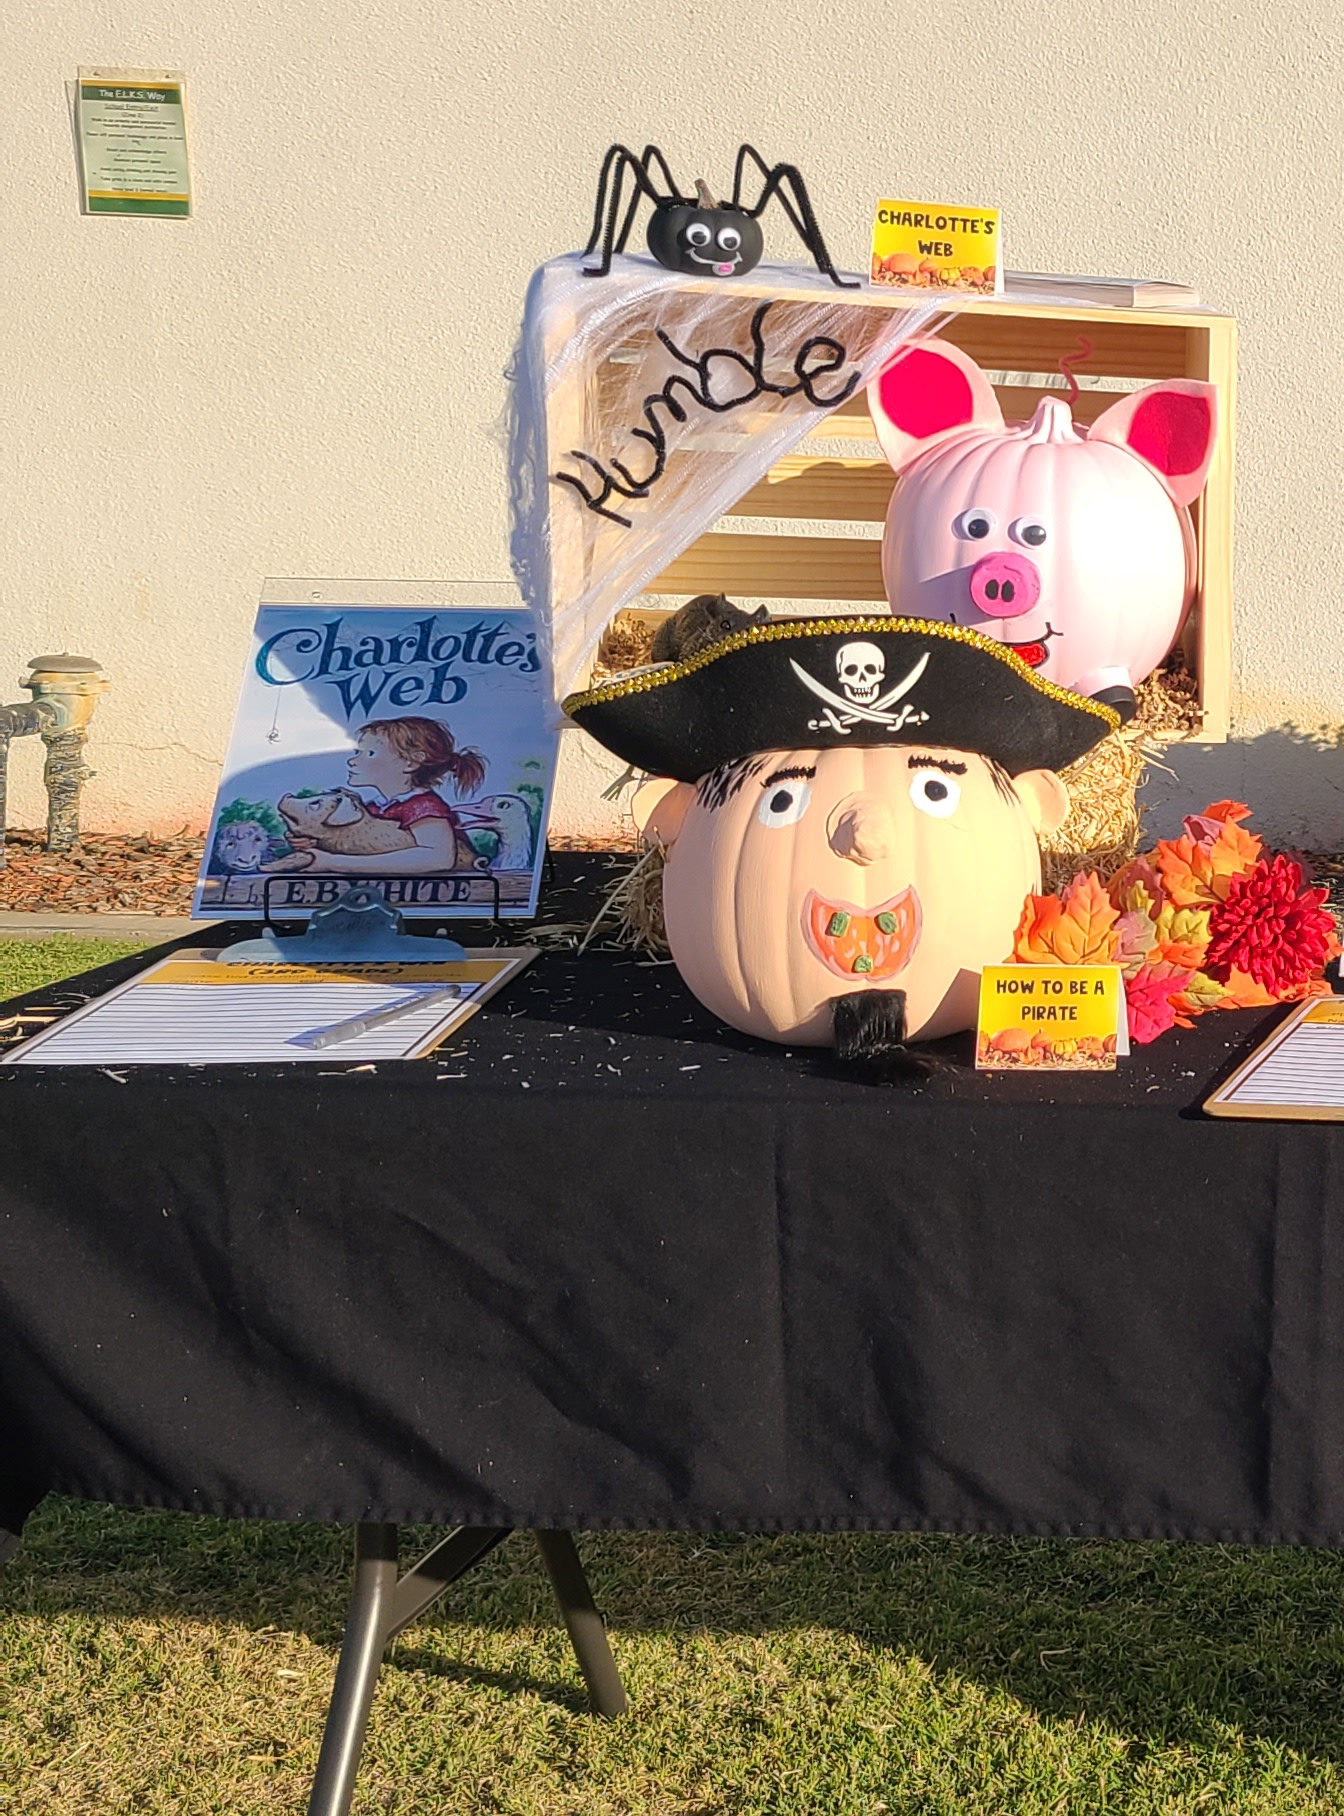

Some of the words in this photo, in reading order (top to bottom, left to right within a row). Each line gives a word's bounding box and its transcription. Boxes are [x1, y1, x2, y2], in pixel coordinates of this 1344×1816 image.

[99, 89, 114, 98] The
[147, 91, 166, 101] Way
[878, 209, 995, 234] CHARLOTTE'S
[918, 240, 953, 256] WEB
[556, 300, 860, 528] Humble
[256, 614, 542, 687] Charlotte's
[325, 661, 467, 723] Web
[996, 979, 1035, 994] HOW
[1041, 980, 1063, 994] TO
[1070, 981, 1088, 994] BE
[1094, 981, 1105, 995] A
[1022, 1005, 1078, 1020] PIRATE
